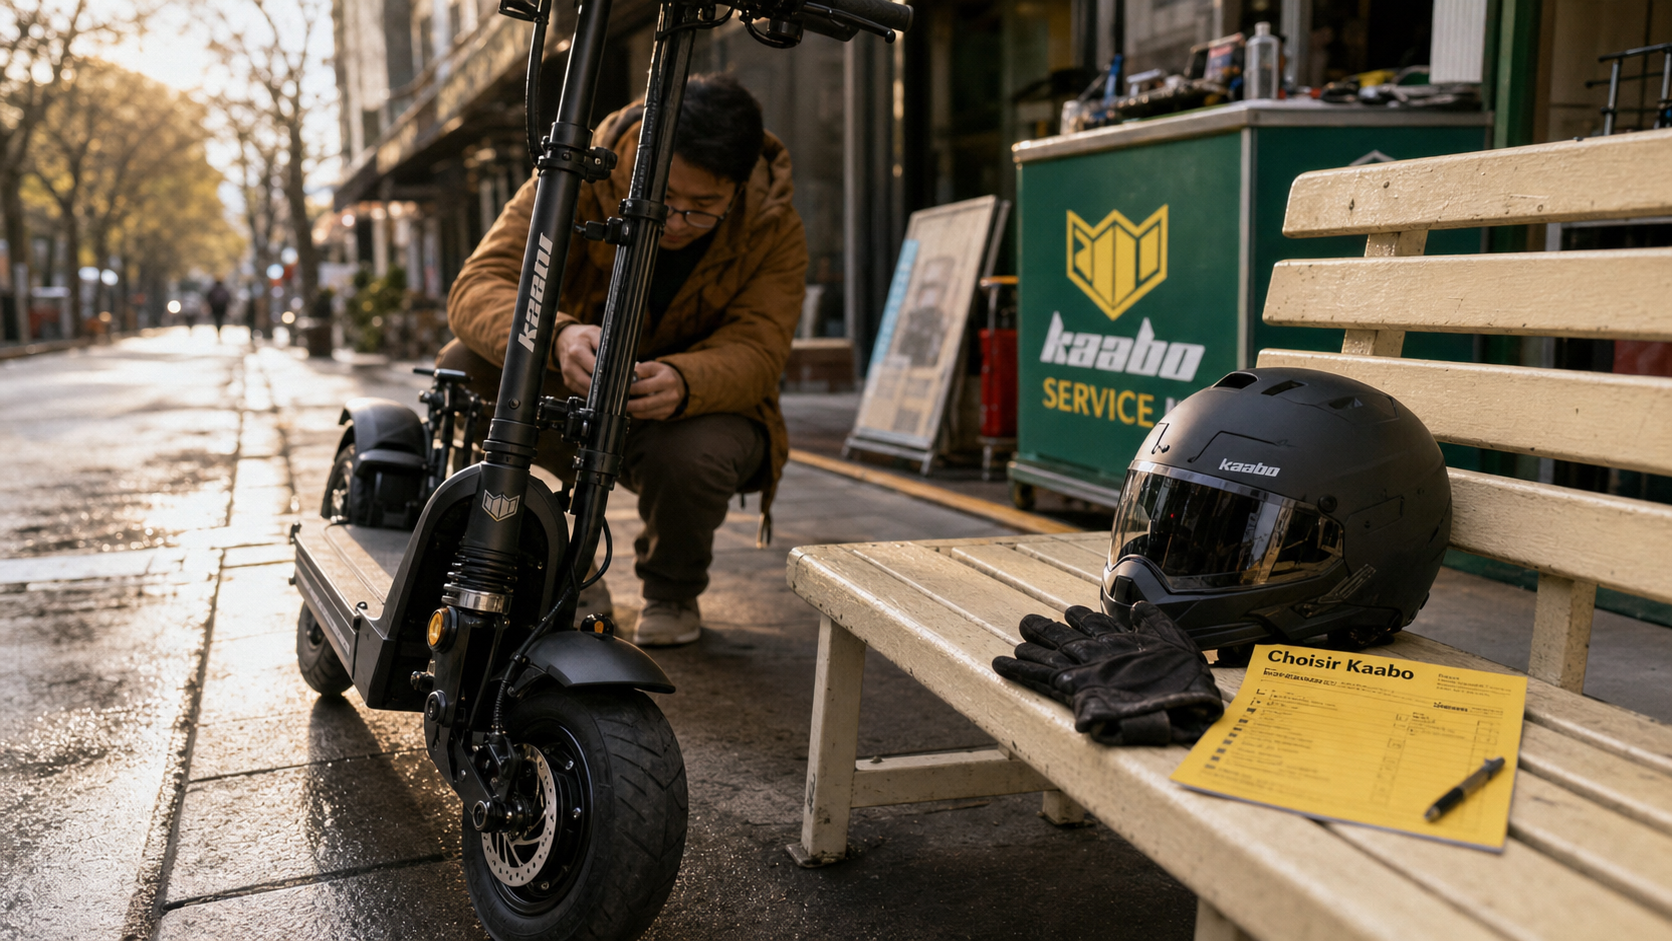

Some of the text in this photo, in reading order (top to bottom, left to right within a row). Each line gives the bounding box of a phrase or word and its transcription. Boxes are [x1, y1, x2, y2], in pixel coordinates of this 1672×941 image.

[1040, 311, 1206, 382] kaabo
[1042, 377, 1155, 428] SERVICE
[1218, 458, 1281, 477] kaabo
[1267, 649, 1341, 670] Choisir
[1346, 659, 1415, 680] Kaabo
